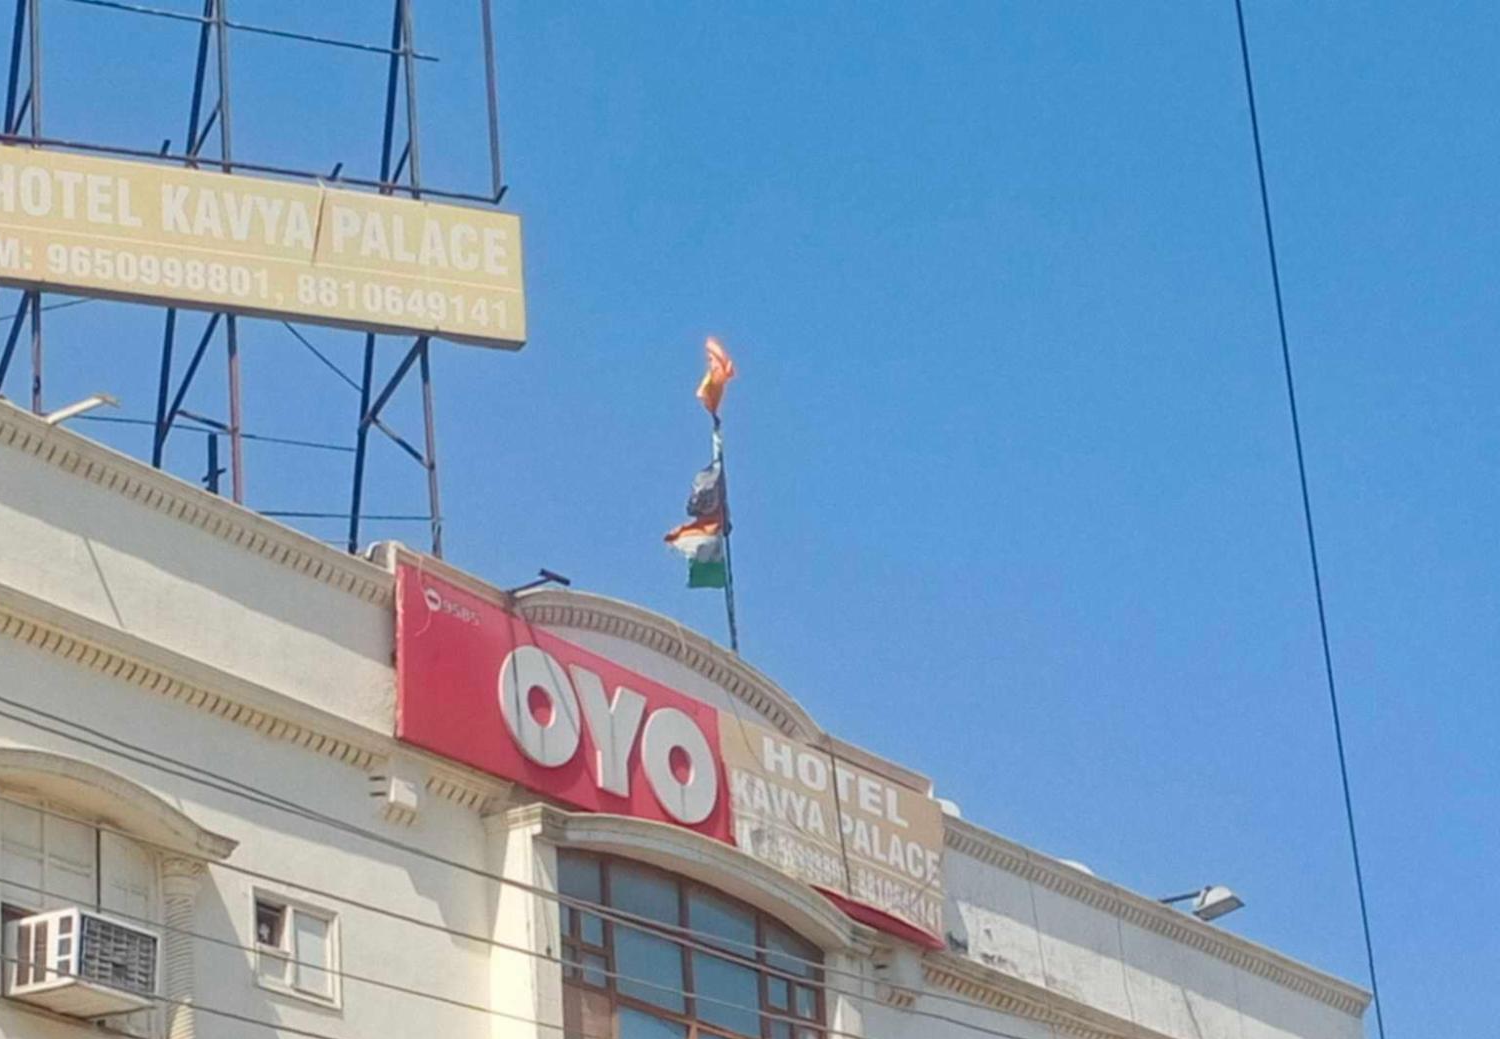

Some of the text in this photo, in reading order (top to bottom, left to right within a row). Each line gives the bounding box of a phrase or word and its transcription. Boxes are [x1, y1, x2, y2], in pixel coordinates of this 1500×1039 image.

[161, 183, 315, 250] KAVYA
[331, 204, 509, 276] PALACE
[47, 242, 285, 306] 9650998801,
[297, 274, 508, 330] 8810649141
[499, 645, 719, 824] OYO
[732, 768, 826, 836] KAVYA
[836, 811, 942, 889] PALACE
[762, 736, 909, 829] HOTEL
